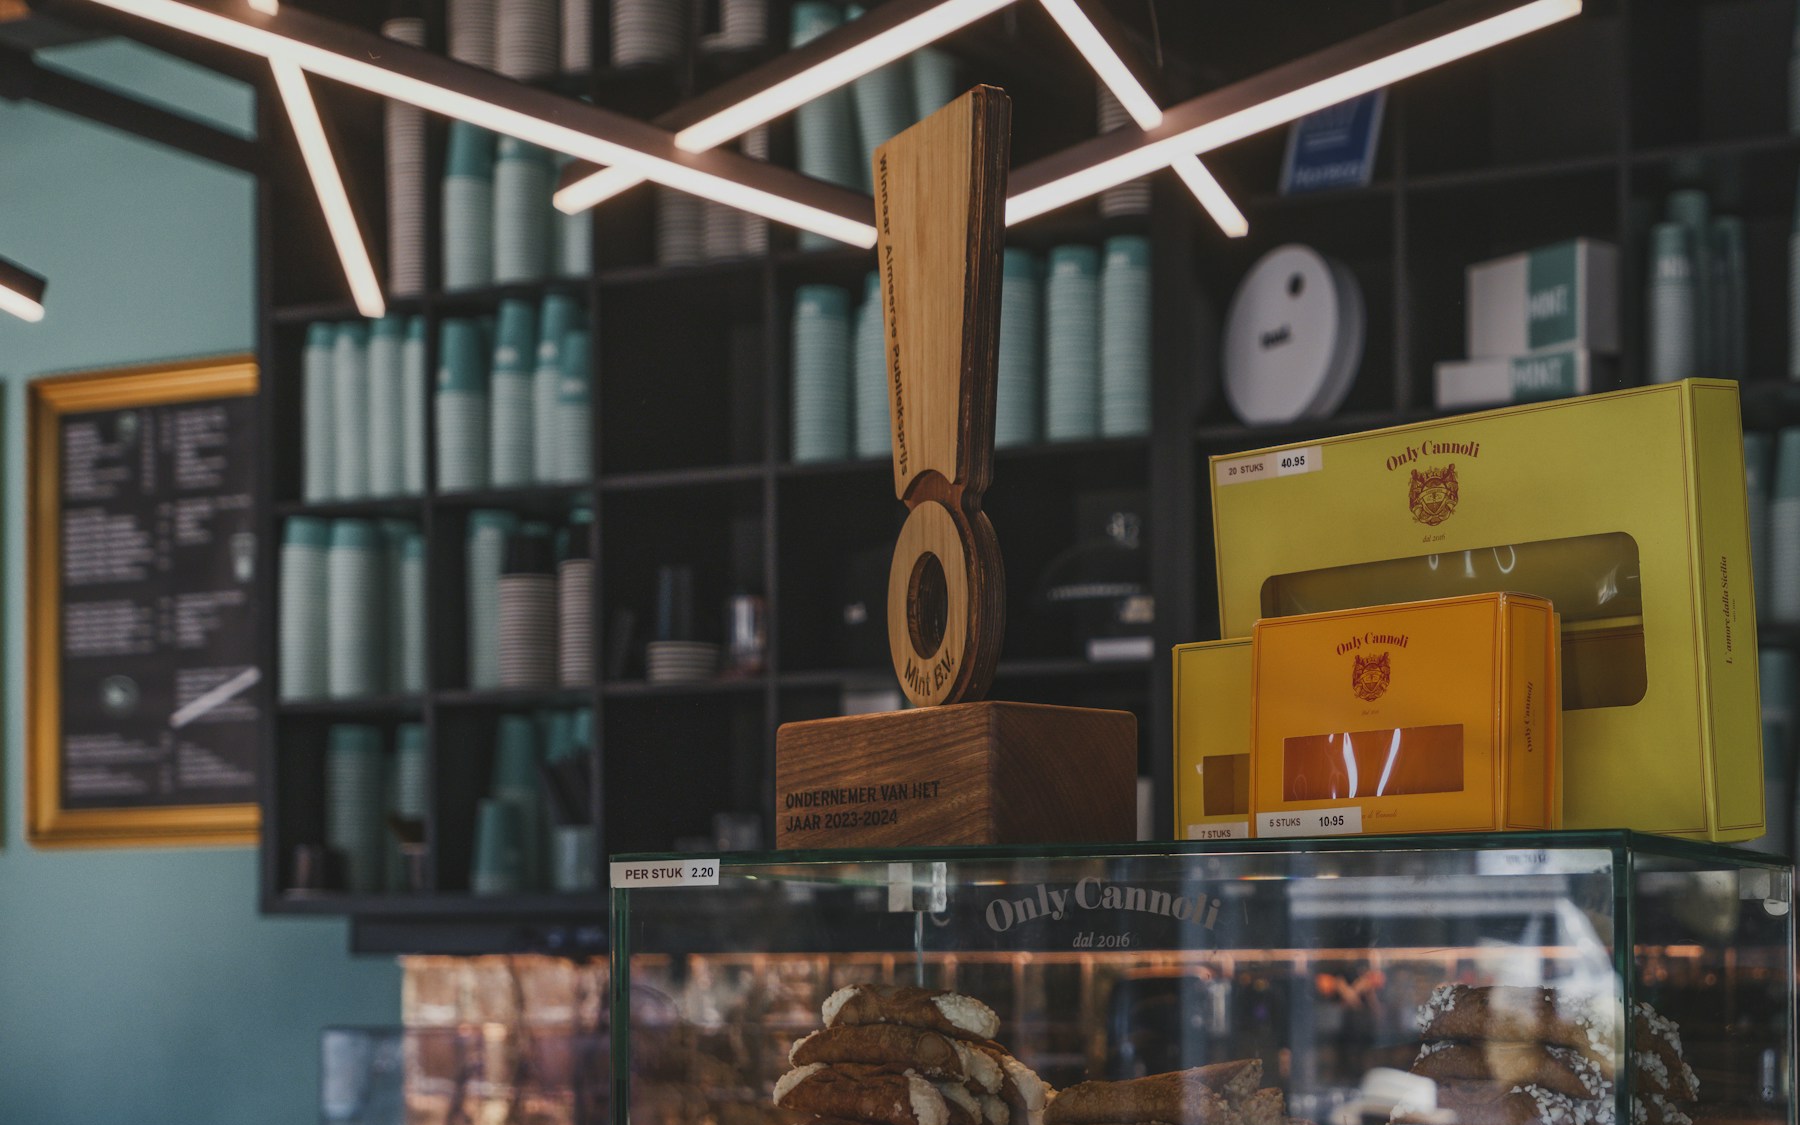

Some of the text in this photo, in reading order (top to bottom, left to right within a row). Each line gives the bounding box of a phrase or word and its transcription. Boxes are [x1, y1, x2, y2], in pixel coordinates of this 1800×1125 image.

[879, 153, 908, 476] Winnaar Almeerse Publieksprijs
[1228, 456, 1305, 476] 20 STUKS 40.95
[1386, 440, 1480, 472] Only Cannoli
[1720, 556, 1729, 589] Sicilia
[1722, 590, 1730, 618] dalla
[1336, 632, 1409, 656] Only Cannoli
[904, 648, 955, 696] Mint B.V.
[785, 780, 941, 809] ONDERNEMER VAN HET
[785, 809, 898, 832] JAAR 2023-2024
[1269, 818, 1274, 827] 5
[1276, 817, 1301, 828] STUKS
[1201, 829, 1231, 839] 7 STUKS
[625, 867, 714, 880] PER STUK 2.20
[985, 876, 1222, 932] Only Cannoli
[1072, 932, 1130, 948] dal 2016
